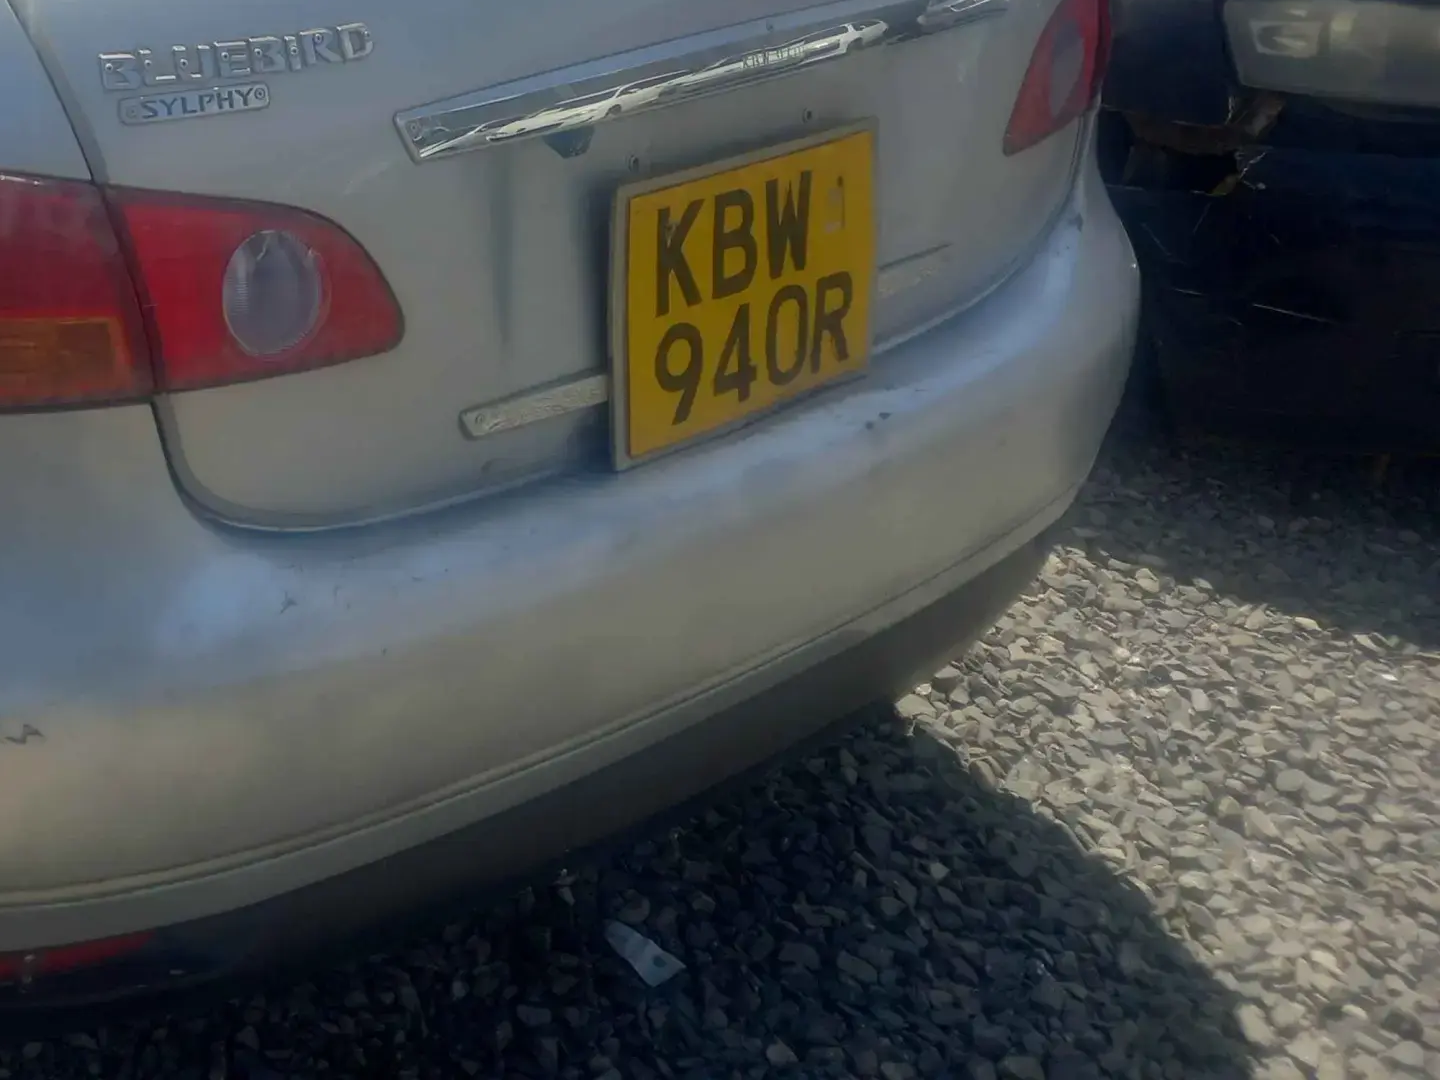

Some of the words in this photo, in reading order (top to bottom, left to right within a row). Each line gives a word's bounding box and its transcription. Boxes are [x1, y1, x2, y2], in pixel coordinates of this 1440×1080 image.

[99, 22, 373, 90] BLUEBIRD
[140, 87, 253, 119] SYLPHY
[655, 171, 812, 317] KBW
[655, 271, 853, 426] 940R
